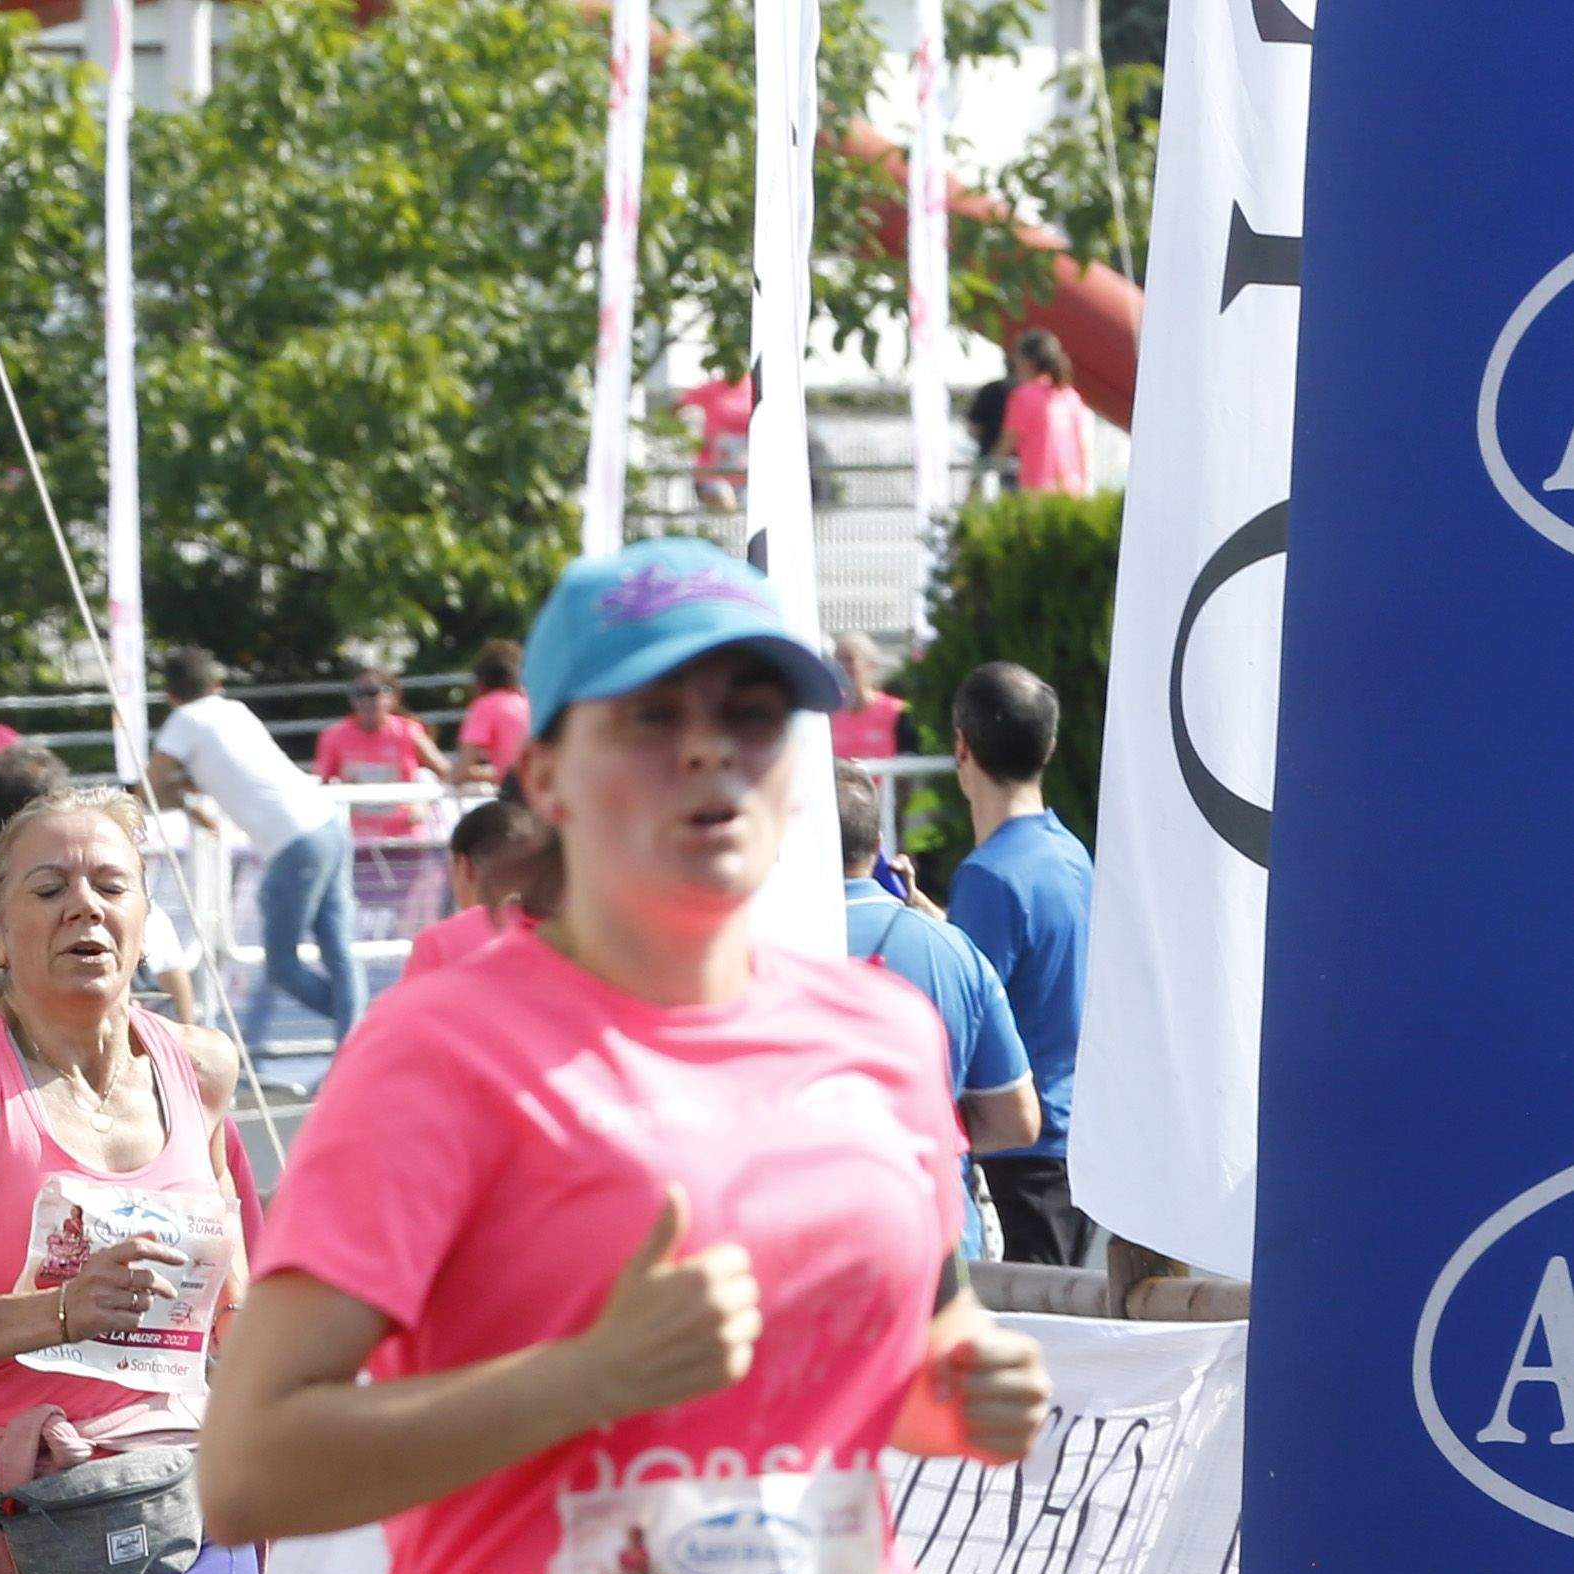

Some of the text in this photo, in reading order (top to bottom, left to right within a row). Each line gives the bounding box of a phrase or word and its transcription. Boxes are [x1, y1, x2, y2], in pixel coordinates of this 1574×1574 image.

[188, 1223, 224, 1237] SUMA
[127, 1333, 163, 1344] MUJER
[131, 1359, 191, 1377] Santander
